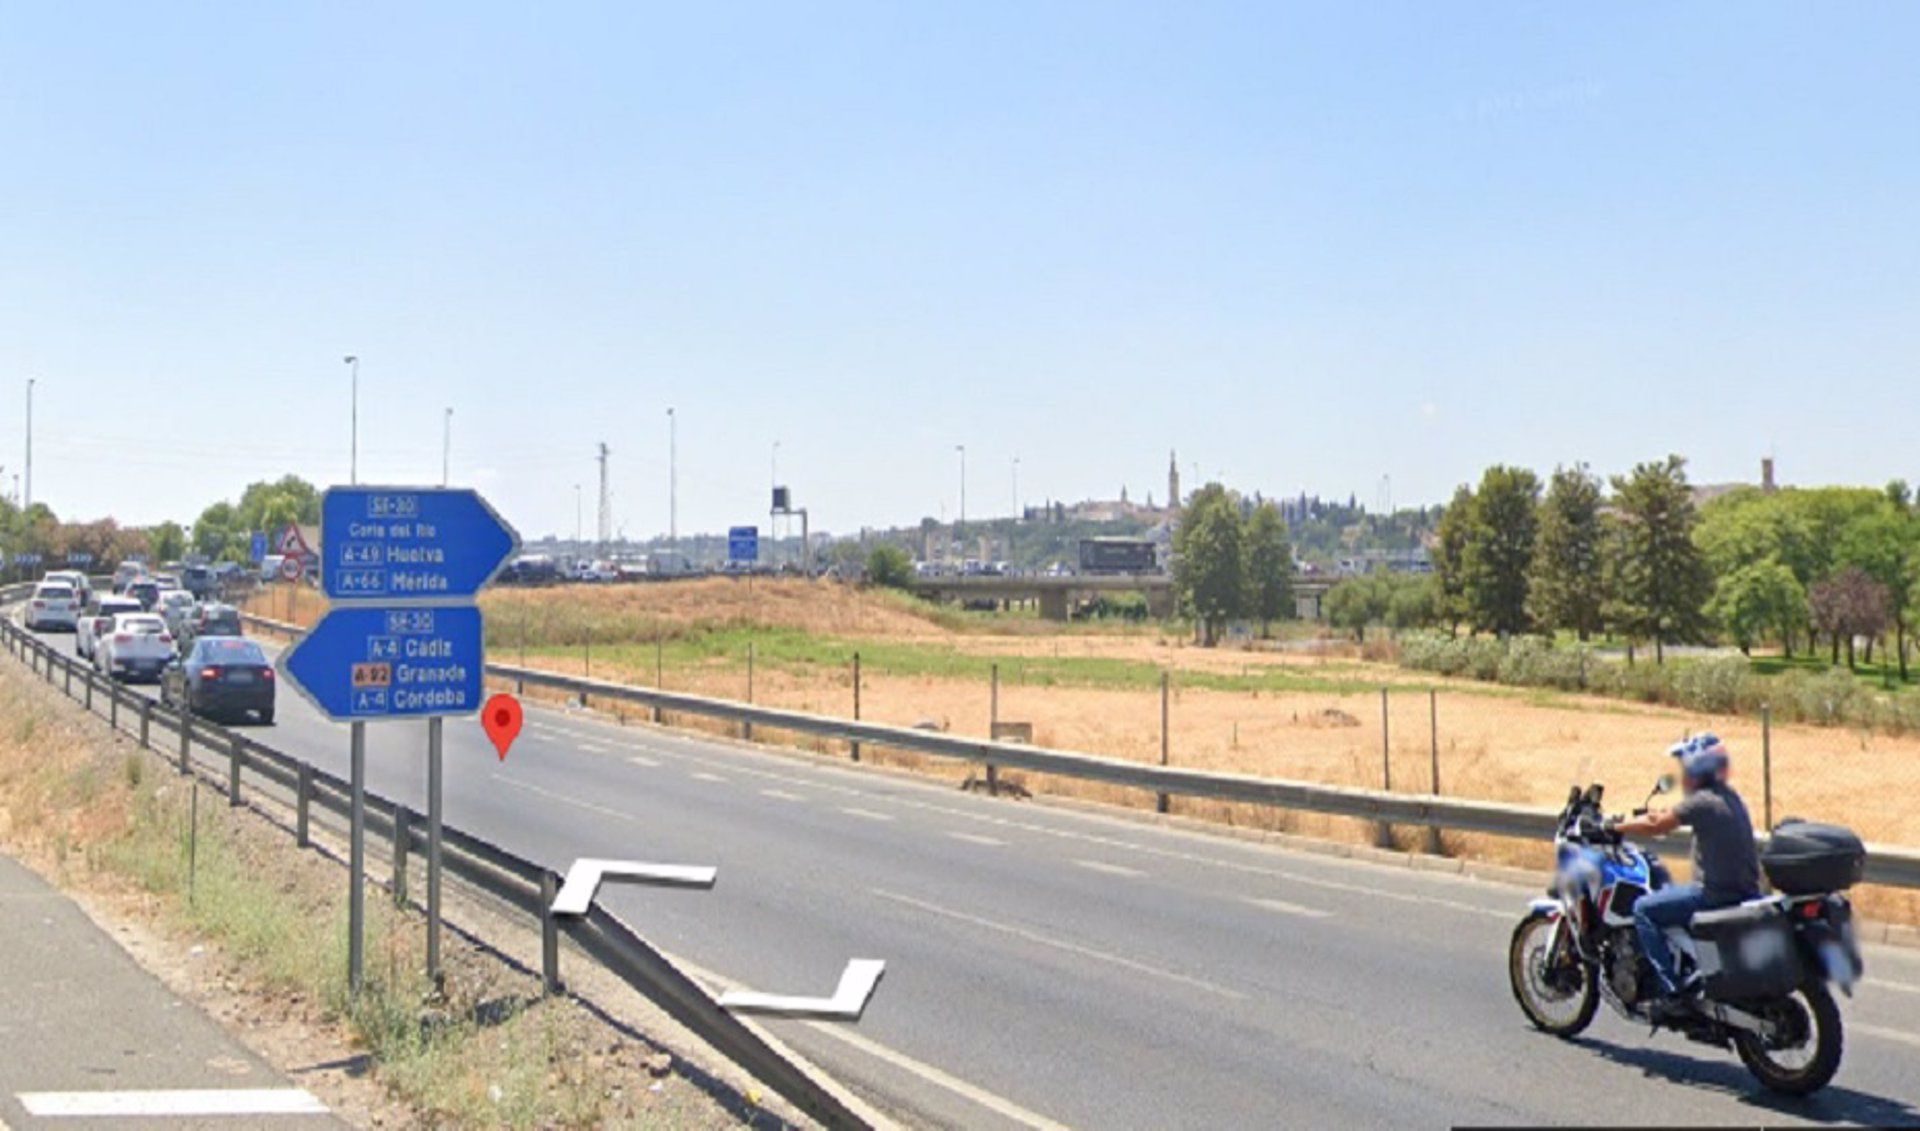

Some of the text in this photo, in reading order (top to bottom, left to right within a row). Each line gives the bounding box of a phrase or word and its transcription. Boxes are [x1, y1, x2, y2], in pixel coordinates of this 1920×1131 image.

[390, 523, 410, 538] del
[344, 545, 444, 563] A-49 Huelva
[343, 572, 381, 590] A-66
[372, 641, 397, 657] A-4
[354, 664, 467, 683] A-92 Granada
[359, 692, 385, 709] A-4
